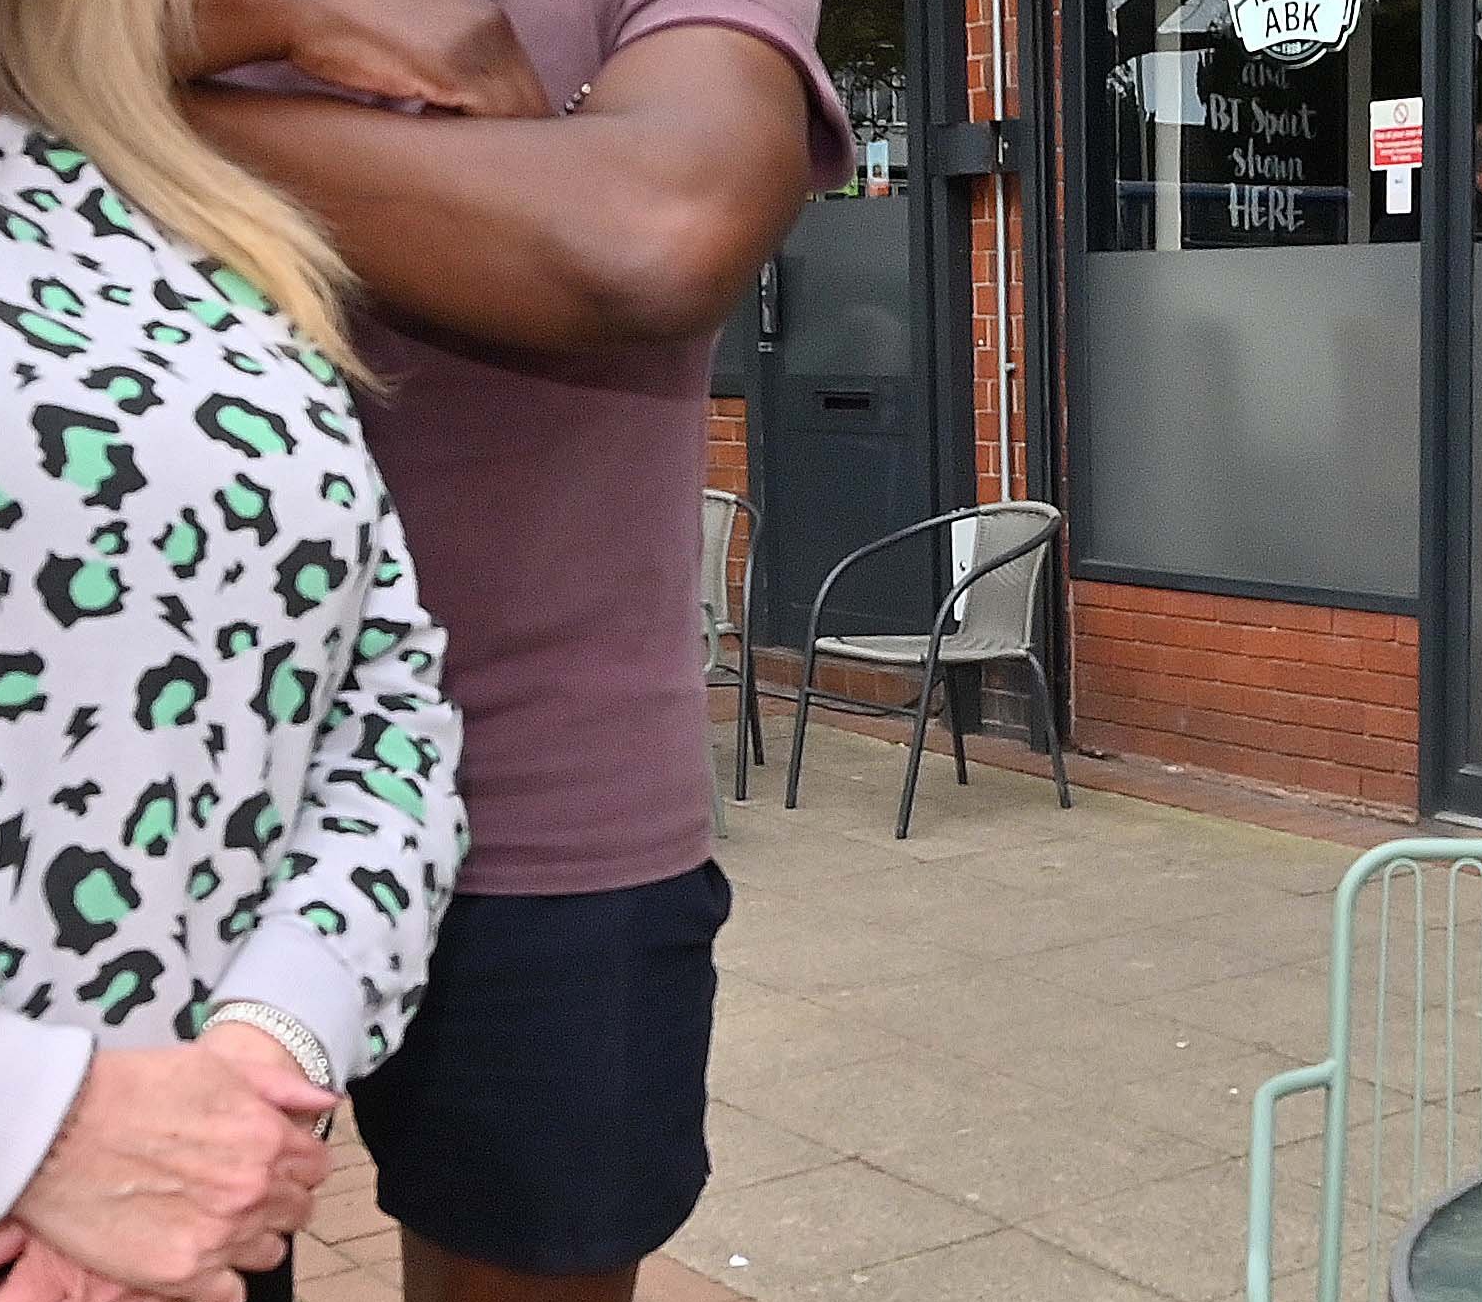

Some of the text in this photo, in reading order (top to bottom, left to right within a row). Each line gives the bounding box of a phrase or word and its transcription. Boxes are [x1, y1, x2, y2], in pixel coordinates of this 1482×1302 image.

[1264, 1, 1322, 40] ABK
[1209, 92, 1317, 144] BT Sport
[1226, 138, 1304, 181] shown
[1226, 182, 1305, 232] HERE
